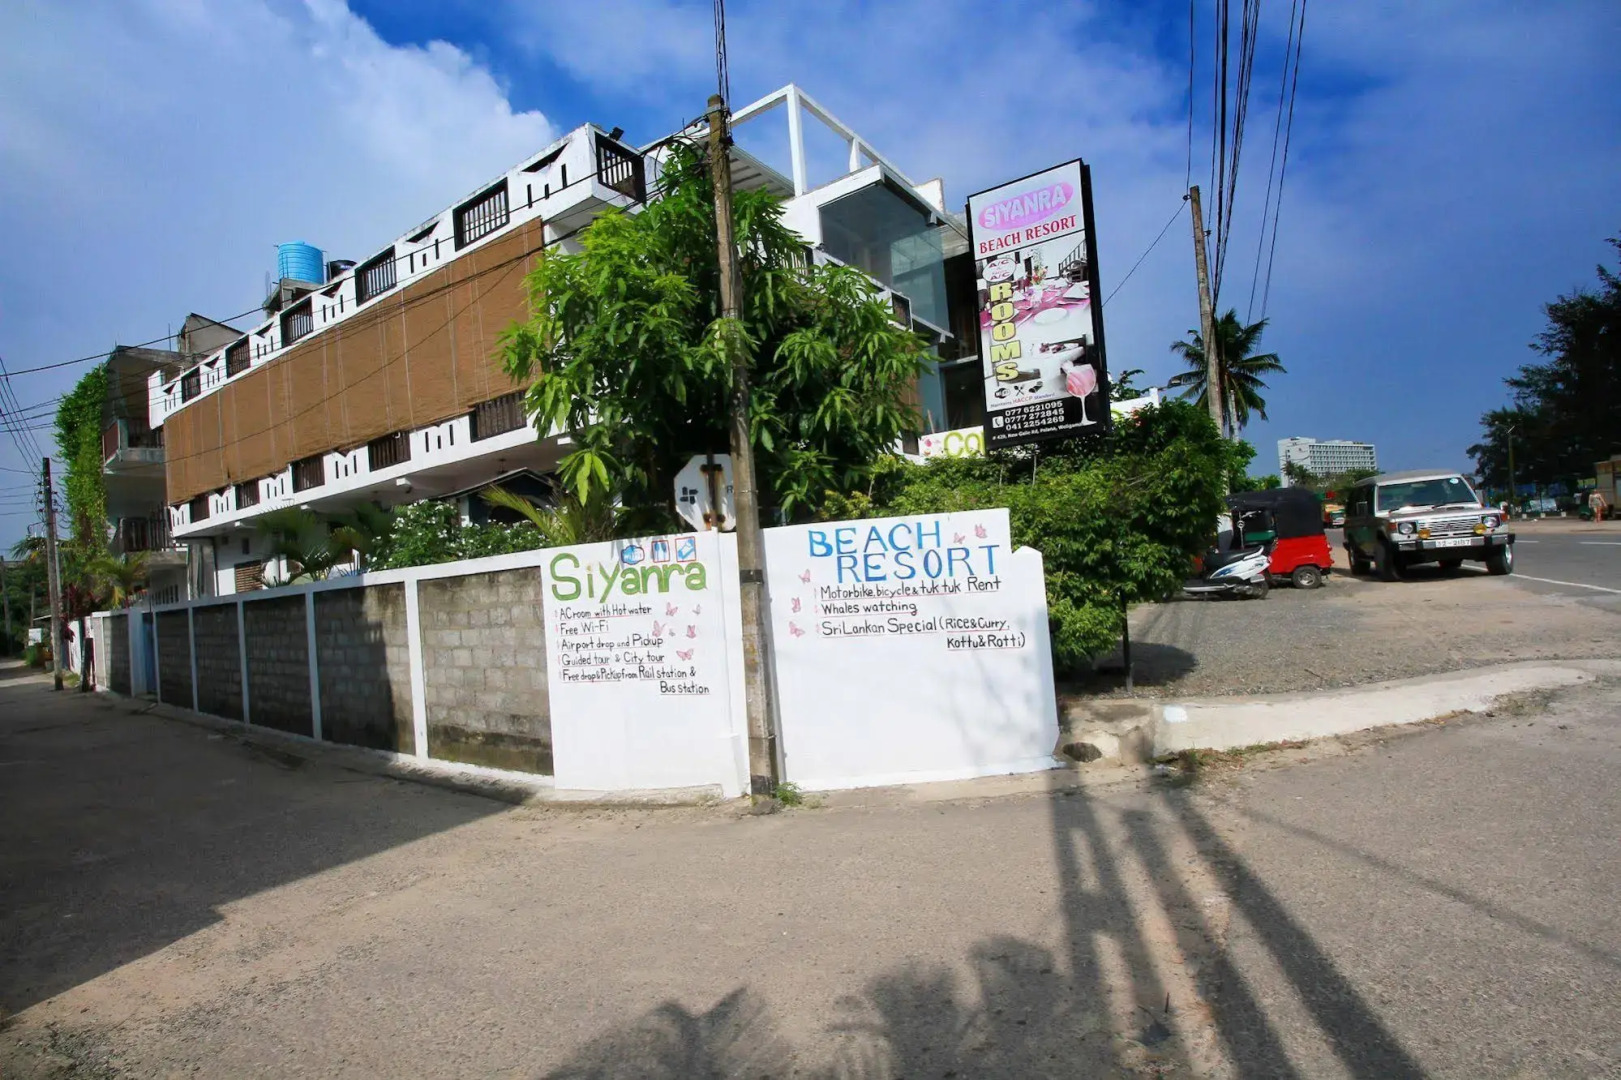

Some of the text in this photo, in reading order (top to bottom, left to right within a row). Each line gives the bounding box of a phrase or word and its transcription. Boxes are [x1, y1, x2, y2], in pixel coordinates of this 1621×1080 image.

[984, 186, 1066, 227] SIYANRA
[980, 215, 1076, 254] BEACH RESORT
[990, 282, 1020, 383] ROOMS
[1005, 408, 1021, 416] 077
[1005, 408, 1064, 424] 0777 272845
[1006, 423, 1022, 431] 041
[808, 520, 941, 557] BEACH
[837, 544, 1000, 583] RESORT
[550, 552, 708, 603] Siyanra
[920, 580, 940, 594] tuk
[942, 579, 961, 593] tuk
[967, 576, 1001, 591] Rent
[594, 604, 610, 616] with
[628, 602, 652, 614] water
[821, 600, 918, 616] Whales watching
[560, 620, 608, 634] Free Wi-Fi
[888, 616, 936, 634] Special
[562, 636, 594, 653] Airport
[596, 637, 614, 651] drop
[617, 636, 630, 646] and
[562, 651, 664, 666] Guided tour & City tour
[562, 668, 580, 681] Free
[638, 665, 655, 678] Rail
[657, 668, 687, 678] station
[690, 666, 696, 678] &
[660, 680, 710, 694] Bus station
